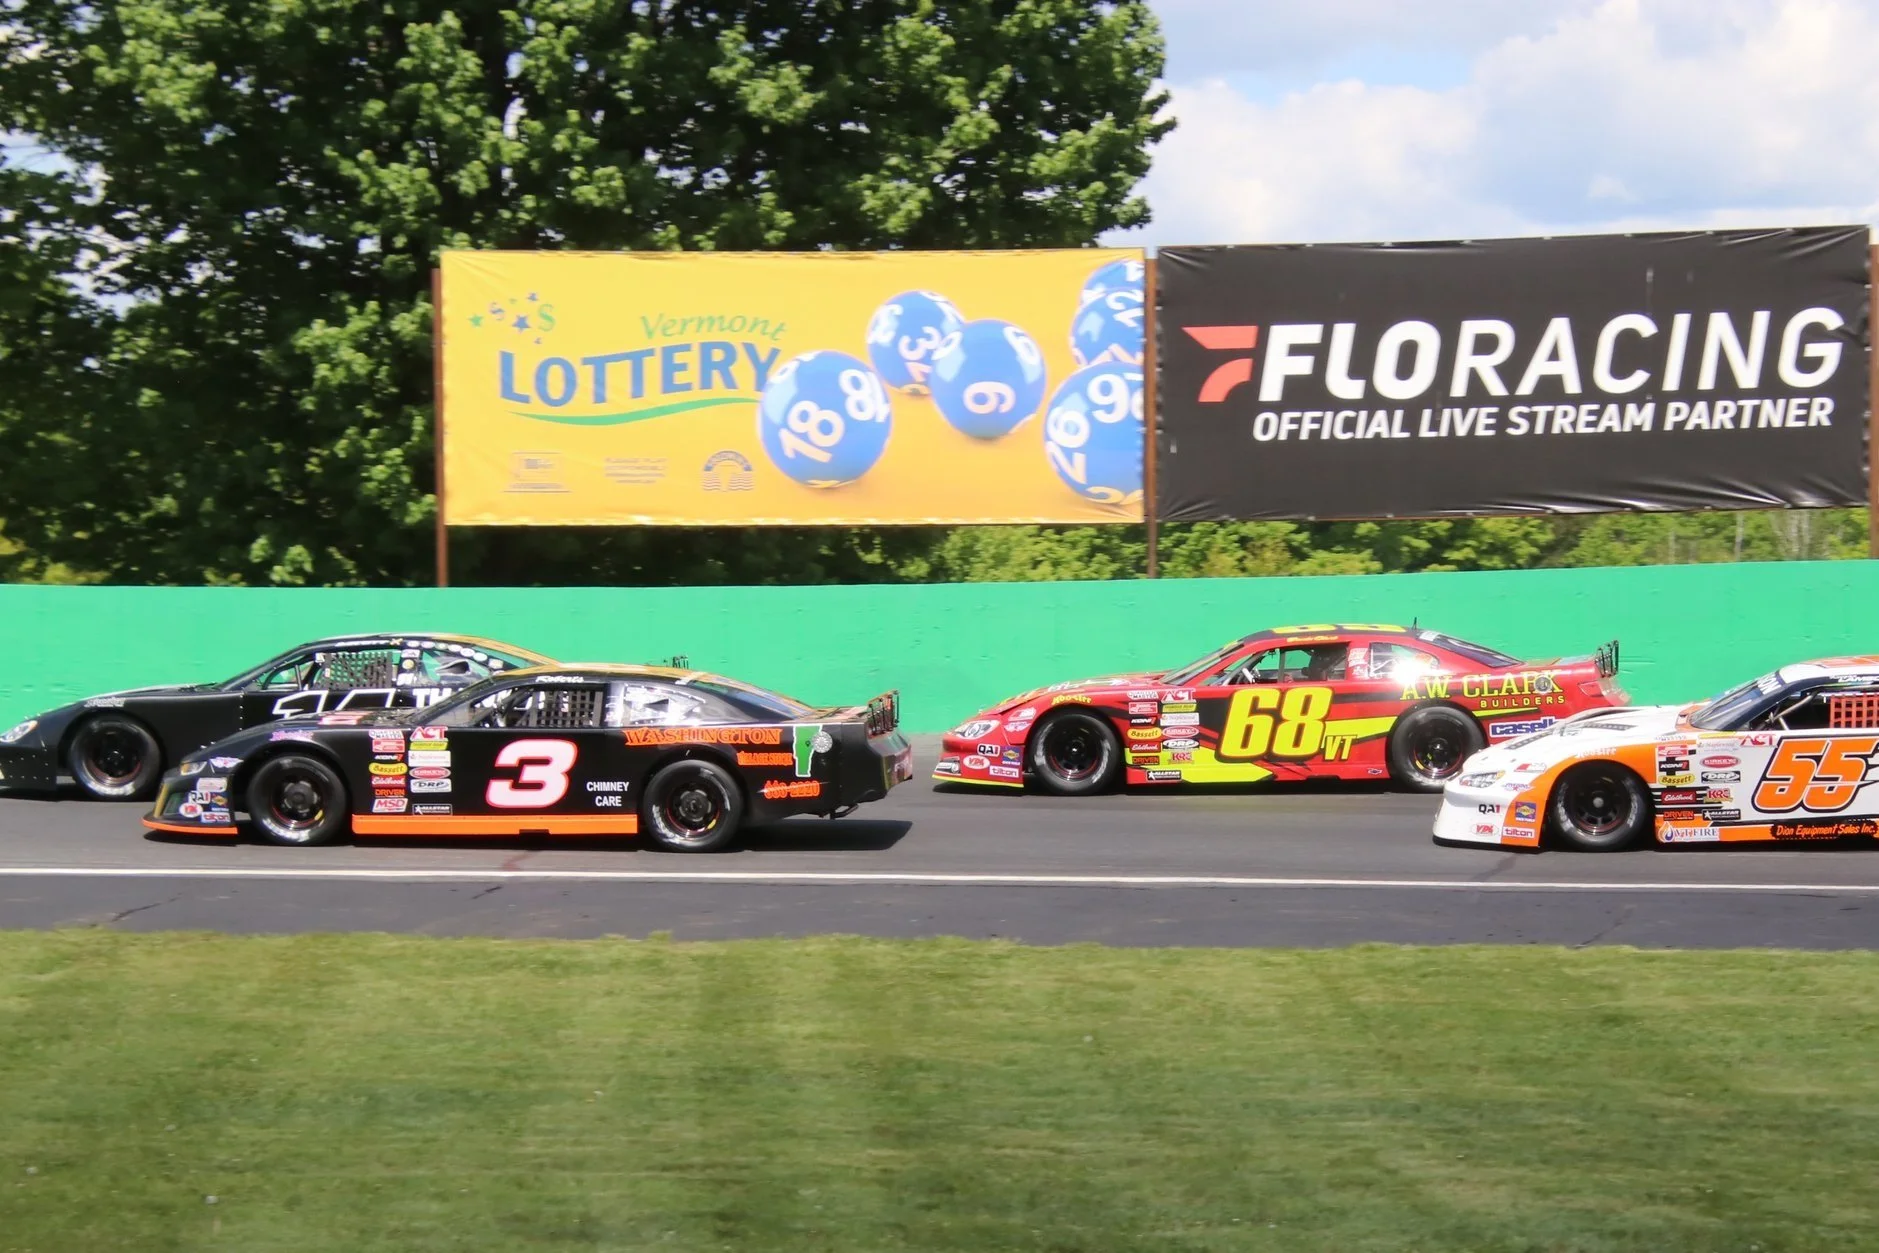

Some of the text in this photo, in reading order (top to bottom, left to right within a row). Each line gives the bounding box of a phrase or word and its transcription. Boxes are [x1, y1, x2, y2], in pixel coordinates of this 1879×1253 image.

[640, 311, 788, 341] Vermont
[499, 340, 782, 408] LOTTERY
[1252, 397, 1835, 442] OFFICIAL LIVE STREAM PARTNER
[1480, 695, 1566, 708] BUILDERS
[1219, 686, 1358, 760] 68 VT
[622, 727, 783, 746] WASHINGTON
[1131, 729, 1158, 738] Bassett
[1740, 734, 1777, 746] ACT
[485, 738, 579, 809] 3
[992, 767, 1018, 776] tilton
[1752, 737, 1878, 813] 55
[586, 781, 630, 792] CHIMNEY
[1661, 776, 1692, 784] Bassett
[595, 796, 623, 806] CARE
[1478, 803, 1501, 814] QA1
[1504, 828, 1533, 837] tilton
[1776, 822, 1877, 839] Dion Equipment Sales Inc.
